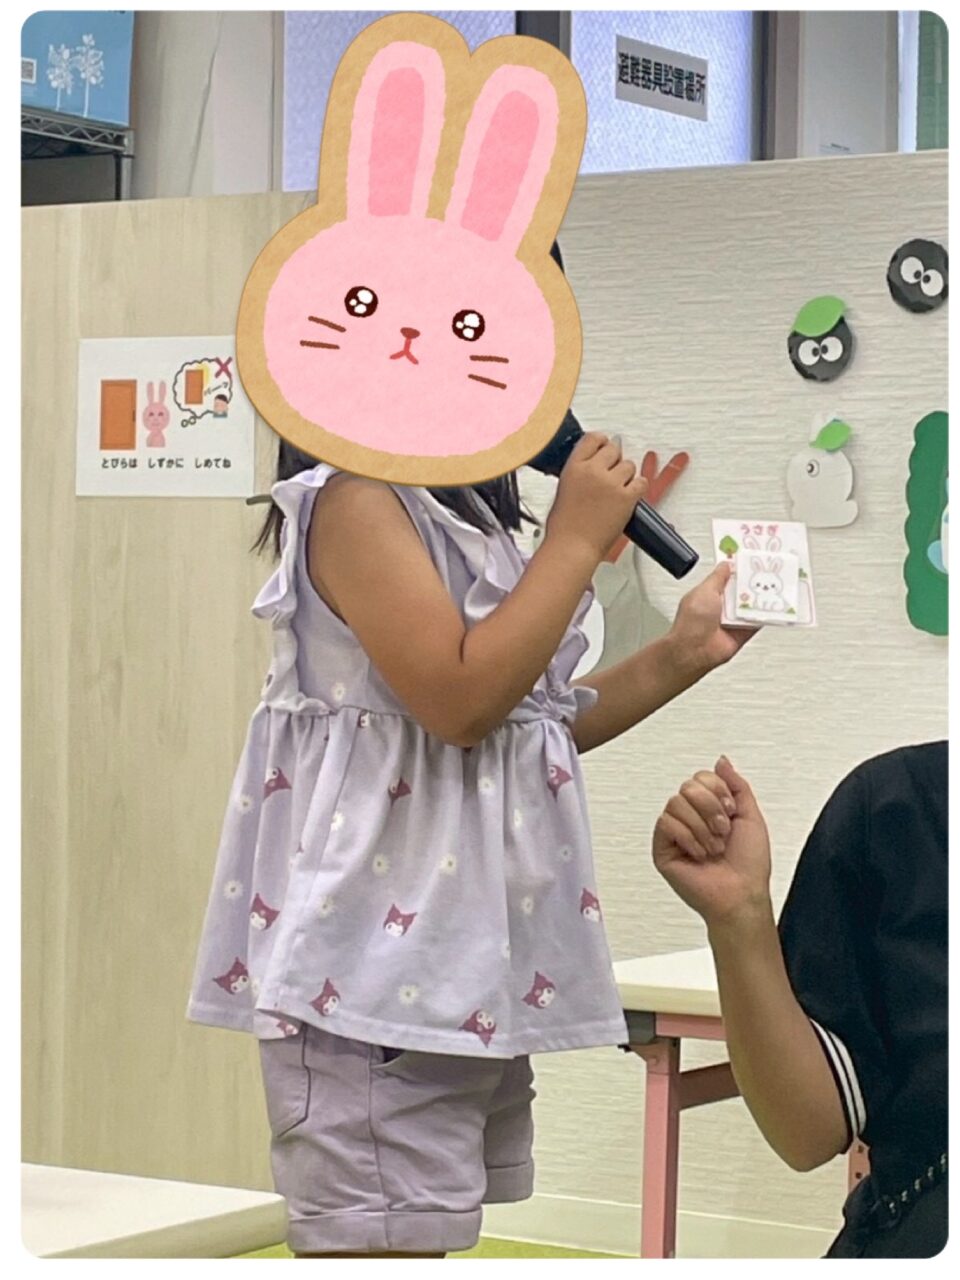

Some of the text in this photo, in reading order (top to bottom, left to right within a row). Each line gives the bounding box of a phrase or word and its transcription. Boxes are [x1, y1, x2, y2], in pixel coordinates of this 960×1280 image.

[617, 51, 706, 105] 避難器具設置場所
[101, 458, 231, 469] とびらは しずかに しめてね
[740, 523, 779, 536] うさぎ
